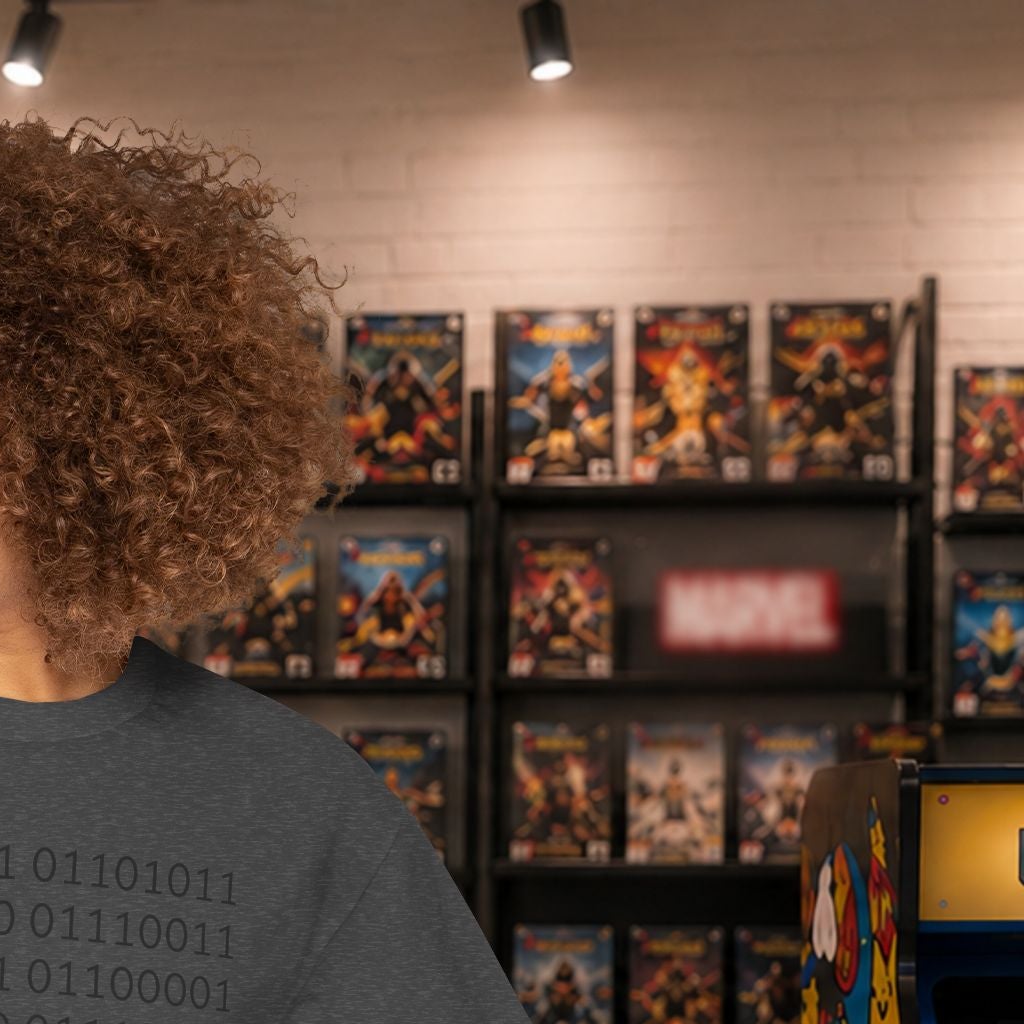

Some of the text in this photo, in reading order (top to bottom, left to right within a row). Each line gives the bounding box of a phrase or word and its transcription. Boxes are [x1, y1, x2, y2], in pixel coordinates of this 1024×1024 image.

[32, 847, 237, 906] 01101011
[29, 902, 234, 959] 01110011
[27, 958, 231, 1013] 01100001
